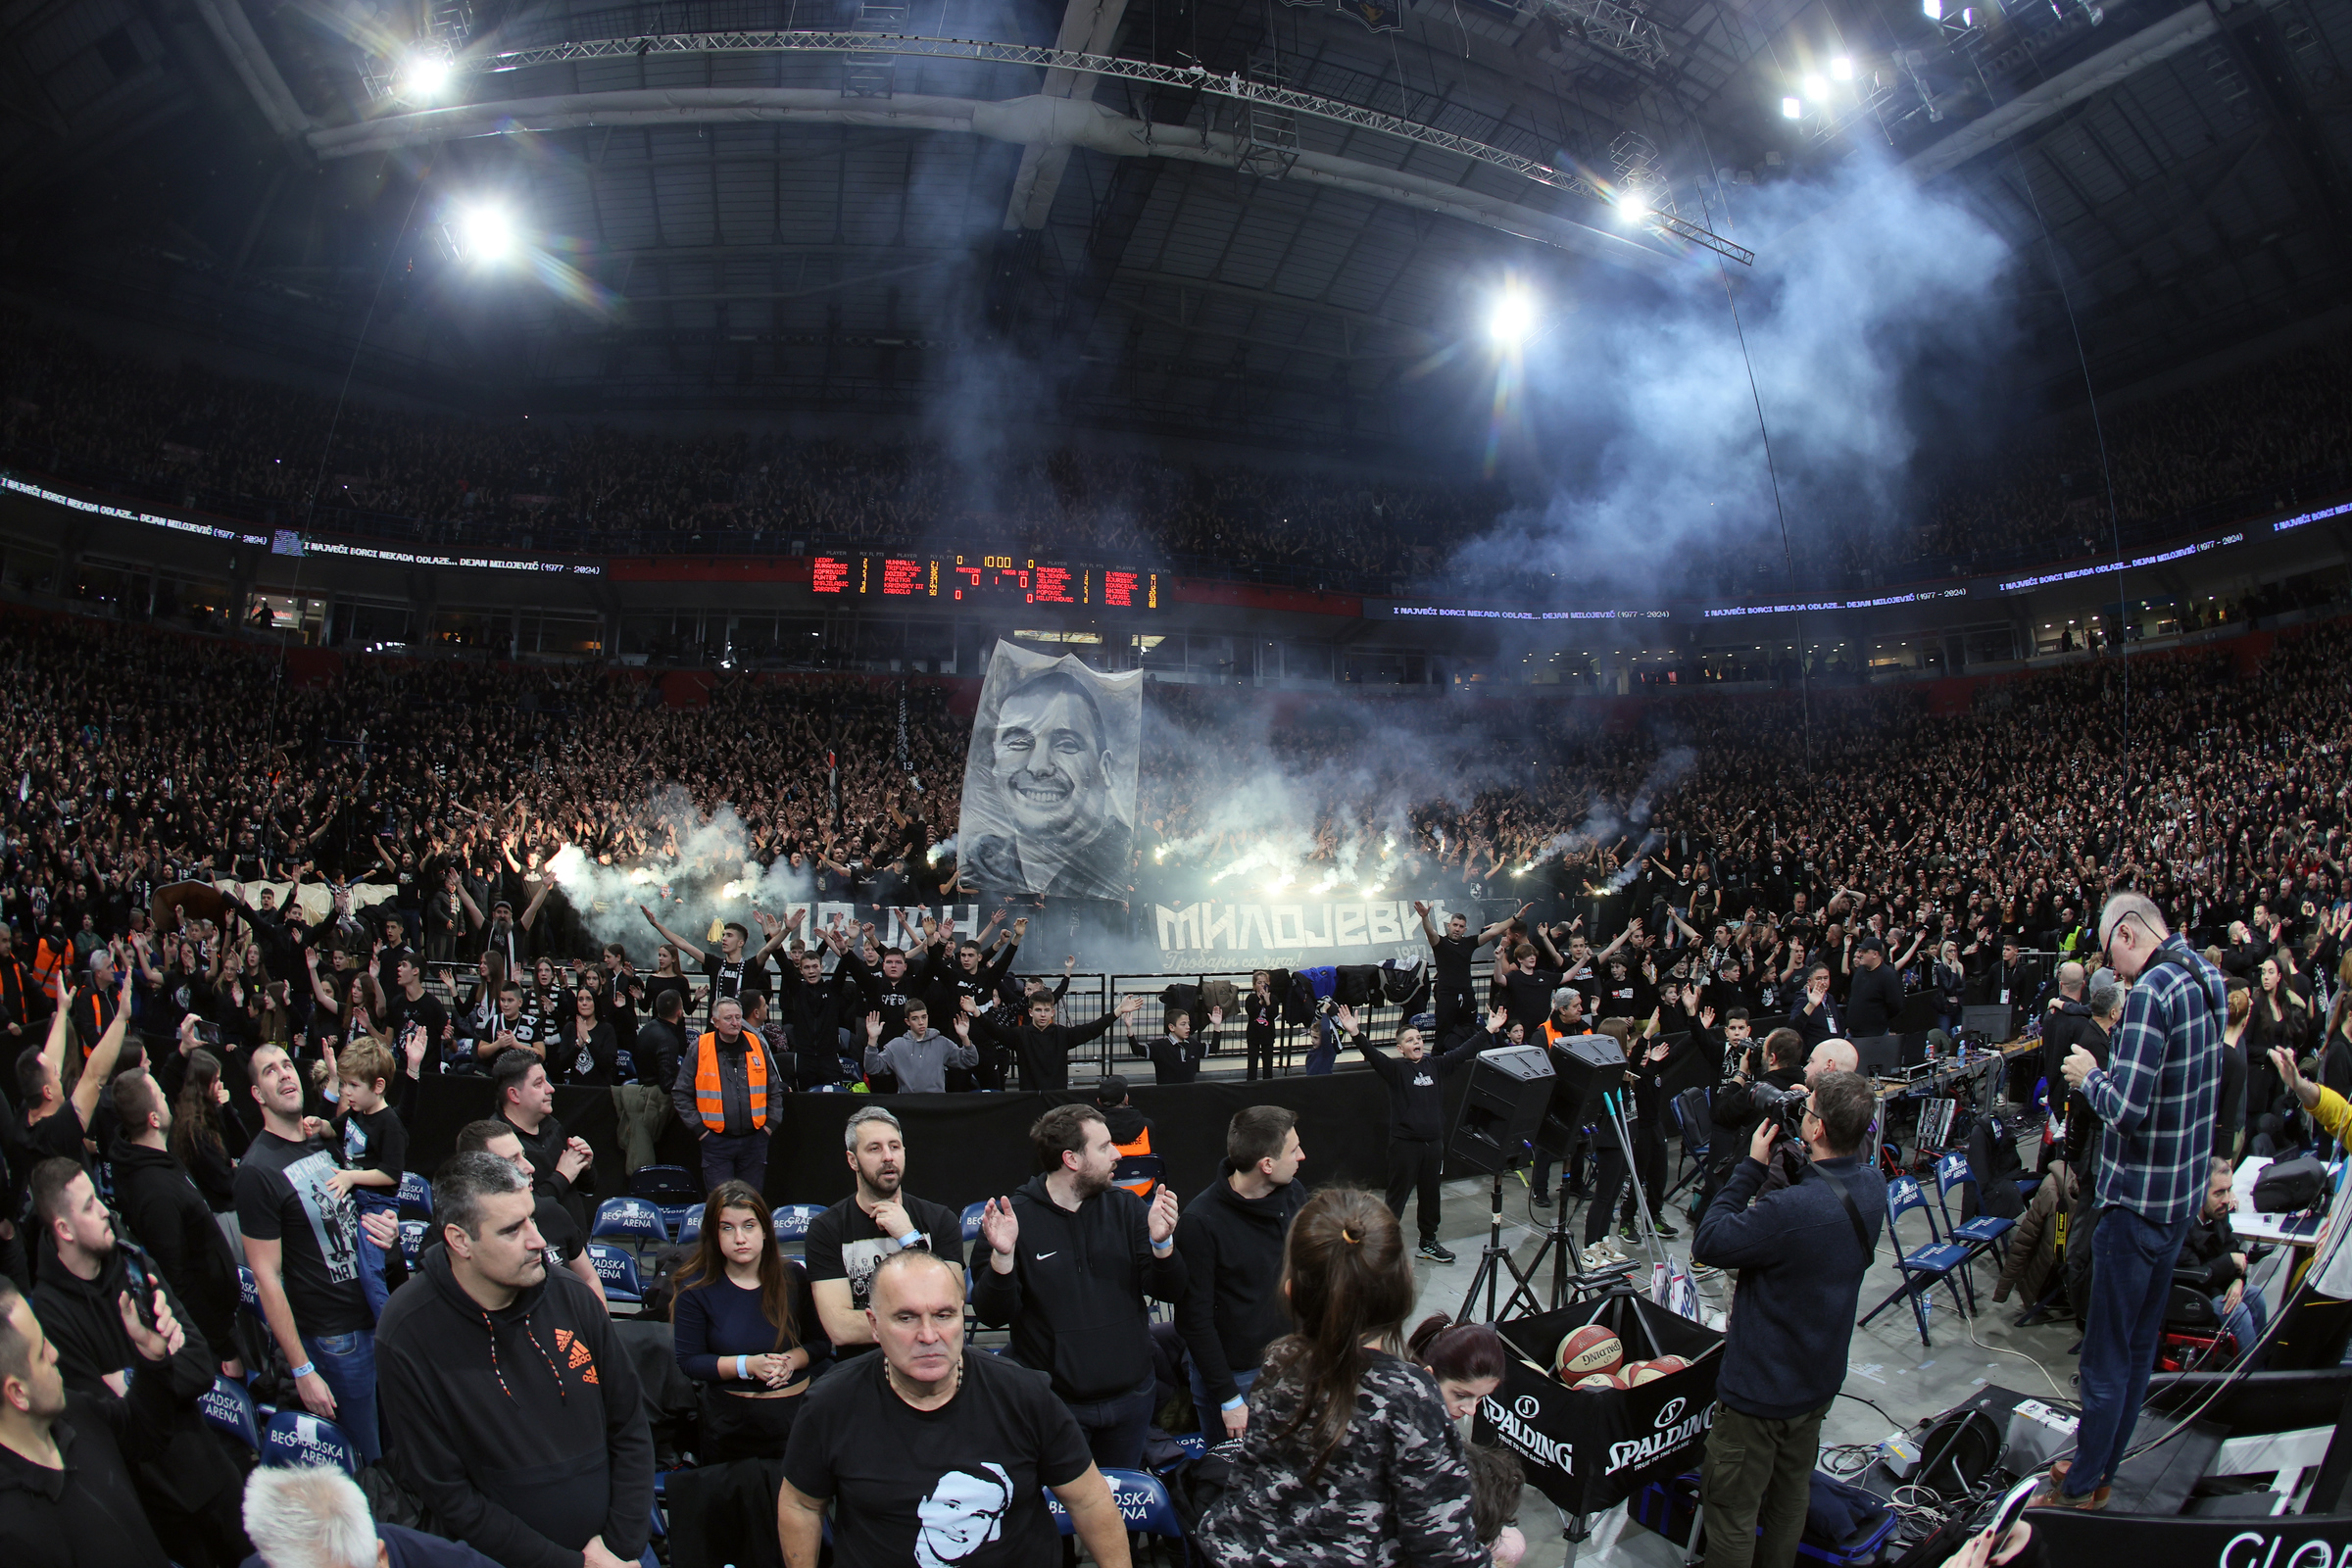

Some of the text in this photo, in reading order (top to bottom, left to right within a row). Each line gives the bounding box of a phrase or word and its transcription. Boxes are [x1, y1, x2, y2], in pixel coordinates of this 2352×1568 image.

[41, 490, 67, 505] BORCI
[67, 498, 99, 513] NEKADA
[139, 513, 167, 526] DEJAN
[214, 528, 235, 540] (1977
[243, 534, 267, 545] 2024)
[2311, 508, 2335, 520] BORCI
[350, 548, 377, 558] BORCI
[379, 551, 414, 563] NEKADA
[460, 558, 487, 567] DEJAN
[541, 563, 564, 572] (1977
[573, 565, 600, 575] 2024)
[956, 555, 963, 565] 0
[1027, 559, 1034, 568] 0
[2039, 573, 2063, 584] BORCI
[2064, 567, 2094, 579] NEKADA
[2132, 557, 2156, 566] DEJAN
[2196, 540, 2215, 552] (1977
[2223, 533, 2243, 545] 2024)
[971, 573, 980, 586] 0
[1020, 576, 1028, 588] 0
[955, 590, 962, 600] 0
[1026, 593, 1034, 604] 0
[1846, 600, 1871, 609] DEJAN
[1916, 591, 1936, 601] (1977
[1944, 588, 1966, 597] 2024)
[397, 1192, 419, 1201] ARENA
[597, 1268, 621, 1279] RENA
[1582, 1340, 1621, 1365] SPALDING
[205, 1403, 239, 1425] ARENA
[1482, 1395, 1574, 1476] SPALDING
[1498, 1433, 1512, 1446] TRUE
[1513, 1442, 1519, 1450] TO
[1520, 1446, 1529, 1457] THE
[1605, 1399, 1717, 1476] SPALDING
[301, 1448, 338, 1466] ARENA
[1634, 1459, 1651, 1471] TRUE
[1660, 1449, 1672, 1458] THE
[2220, 1531, 2352, 1568] GLO
